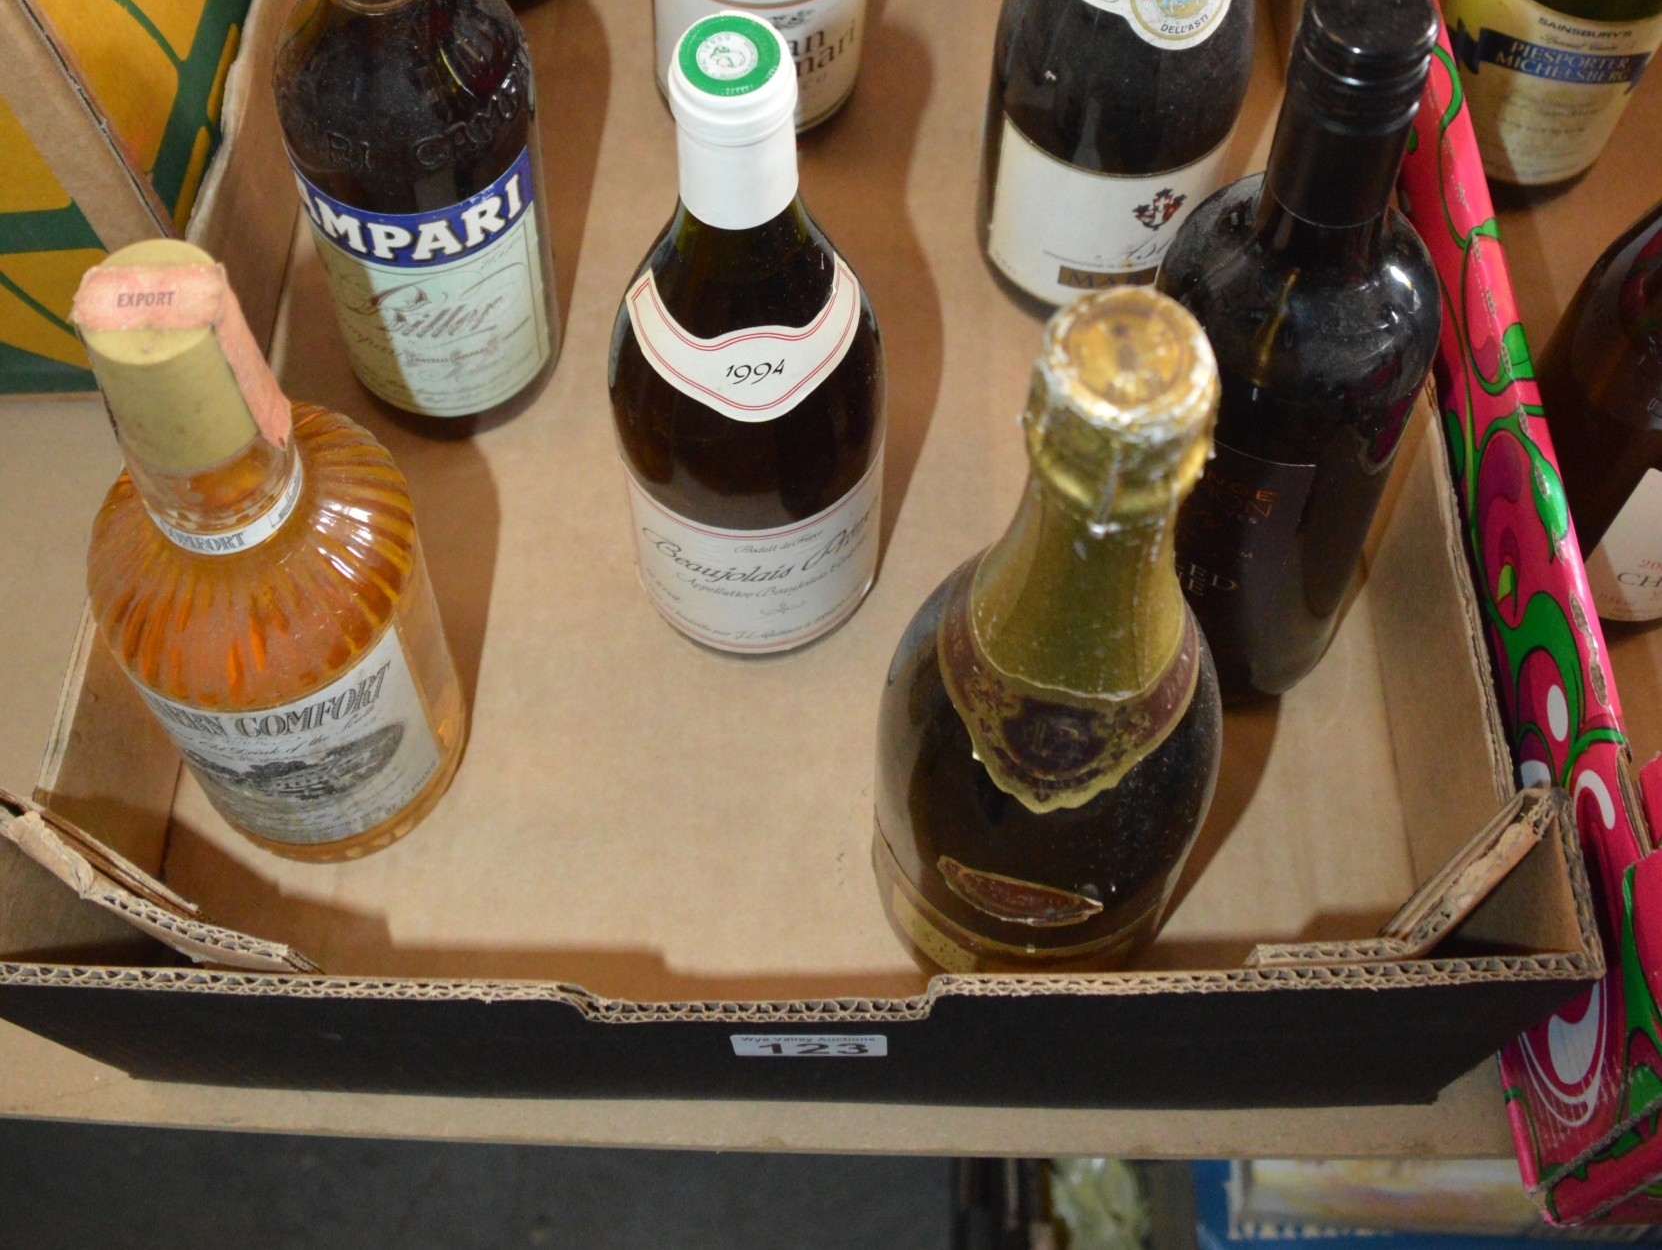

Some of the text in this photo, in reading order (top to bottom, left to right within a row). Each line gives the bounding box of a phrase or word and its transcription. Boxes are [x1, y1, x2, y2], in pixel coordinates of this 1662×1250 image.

[1160, 13, 1210, 35] DELL'ASTI
[1537, 16, 1633, 39] SAINSBURY'S
[791, 29, 826, 57] an
[1510, 40, 1631, 70] PIESPORTER
[1495, 52, 1628, 82] MICHELSBERG
[296, 172, 524, 262] AMPARI
[116, 290, 175, 309] EXPORT
[725, 358, 786, 386] 1994
[641, 526, 795, 583] Beaujolais
[234, 659, 392, 738] COMFORT
[758, 1043, 869, 1055] 123
